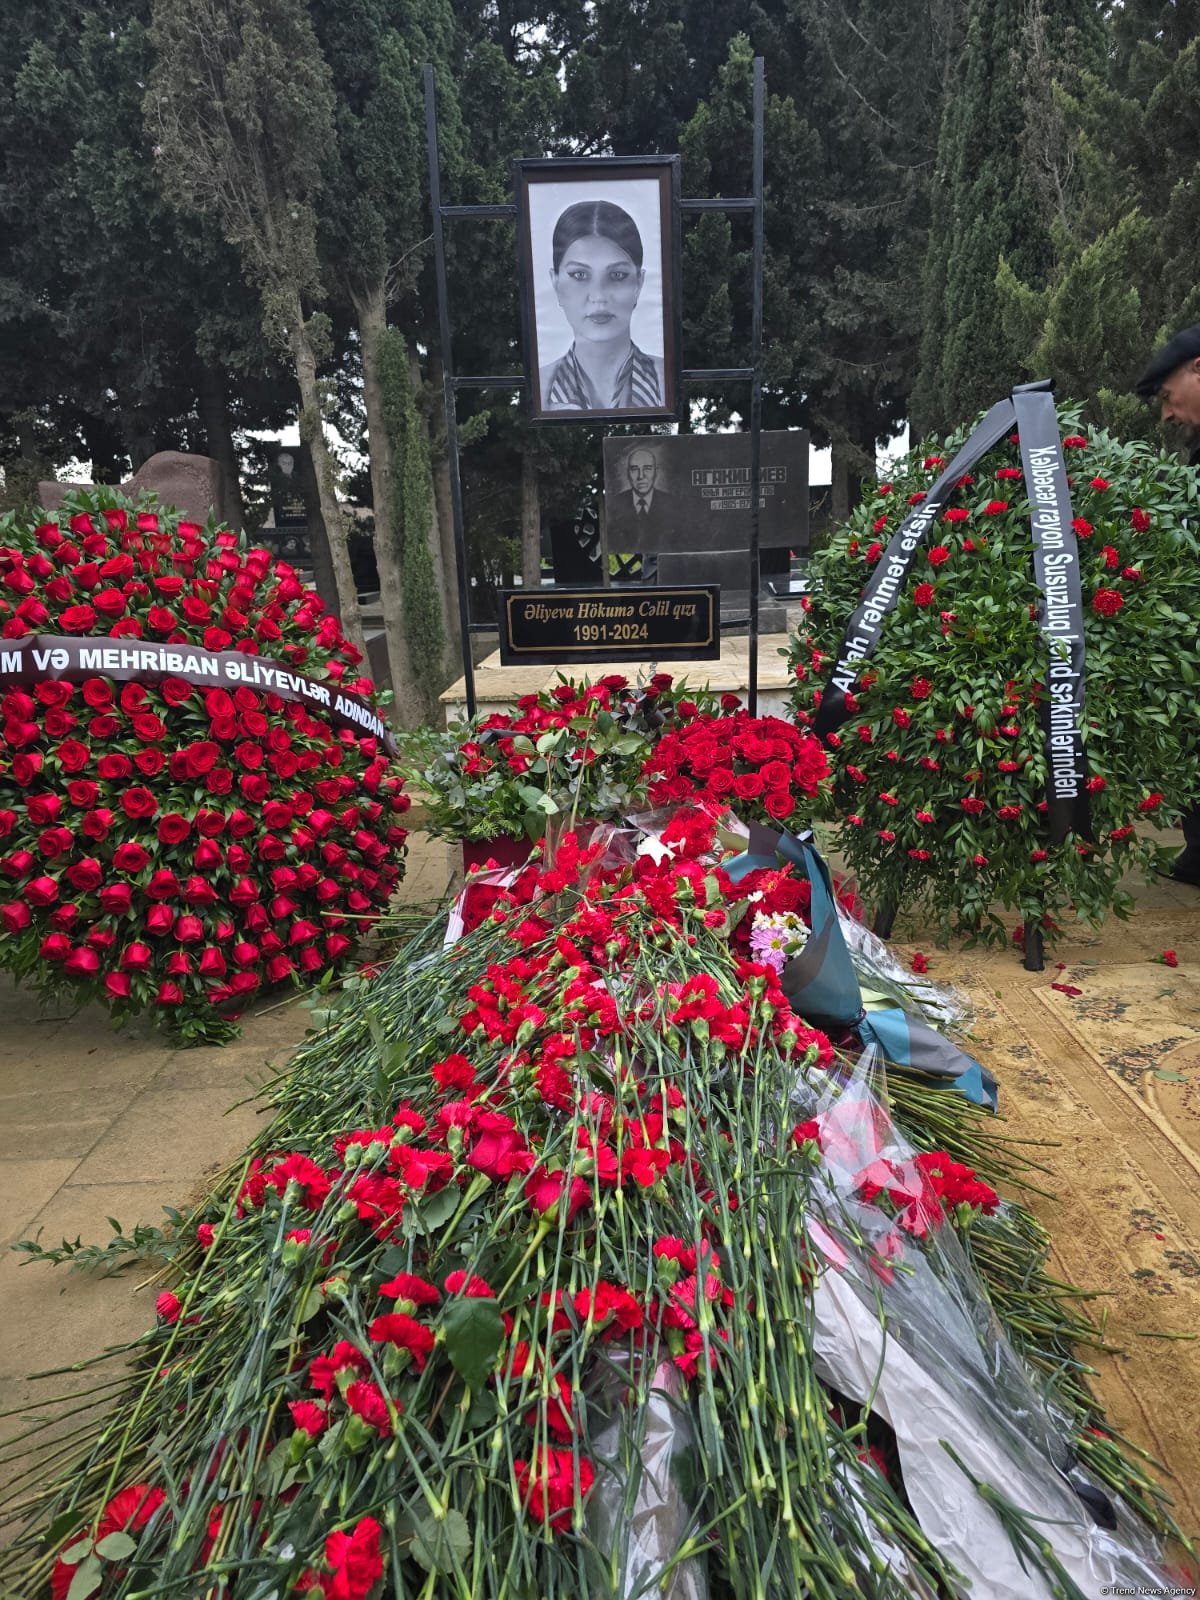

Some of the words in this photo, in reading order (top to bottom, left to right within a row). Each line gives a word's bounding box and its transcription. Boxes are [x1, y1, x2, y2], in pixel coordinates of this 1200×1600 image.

[1028, 445, 1060, 506] Kəlbəcər
[1033, 508, 1064, 550] rayon
[858, 554, 910, 633] rəhmət
[900, 502, 942, 551] etsin
[1041, 553, 1077, 631] Susuzluq
[524, 603, 574, 623] Əliyeva
[577, 602, 635, 620] Hökumə
[639, 600, 671, 618] Cəlil
[672, 603, 696, 620] qızı
[573, 623, 649, 641] 1991-2024
[32, 648, 70, 671] VƏ
[80, 649, 219, 676] MEHRİBAN
[225, 661, 331, 706] ƏLİYEVLƏR
[334, 694, 384, 739] ADINDAN
[1050, 682, 1084, 799] sakinlərindən
